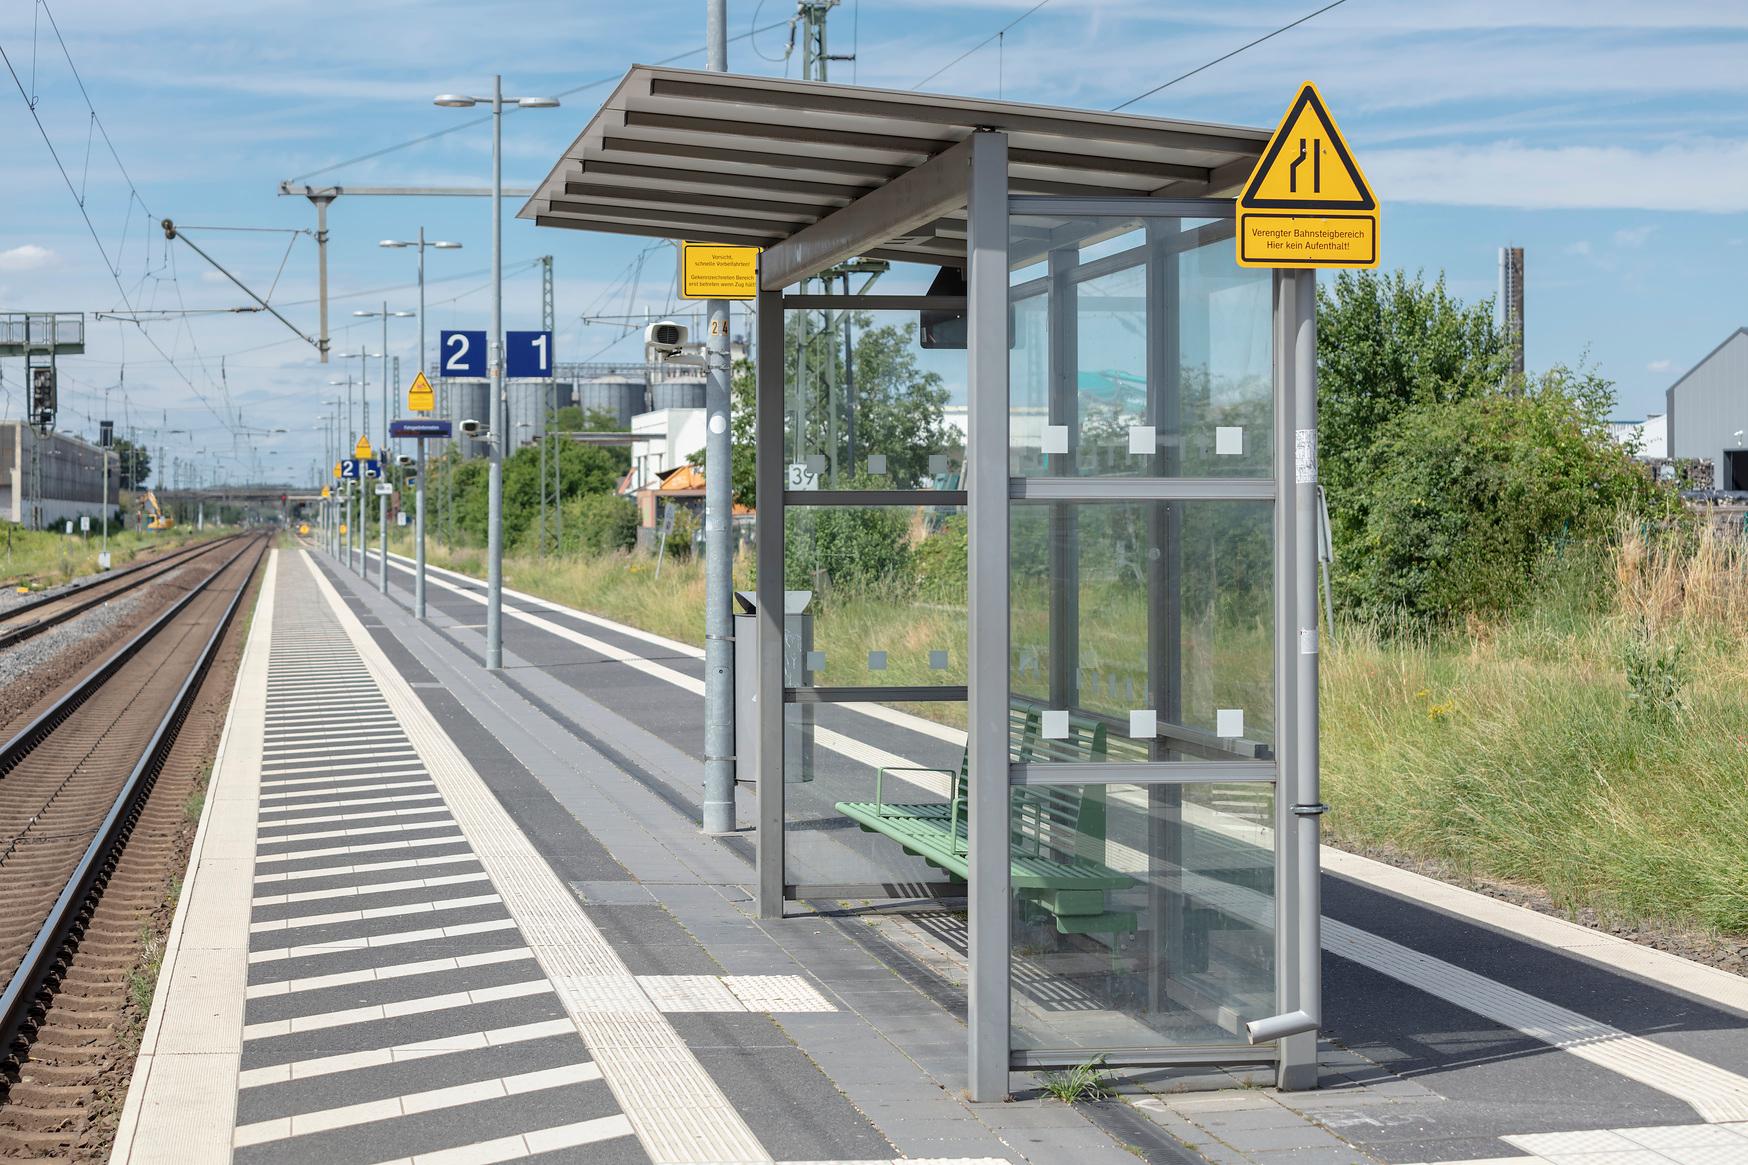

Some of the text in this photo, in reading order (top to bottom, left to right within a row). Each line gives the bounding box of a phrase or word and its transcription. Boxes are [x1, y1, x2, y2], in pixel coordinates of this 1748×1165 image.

[1252, 228, 1365, 239] Verengter Bahnsteigbereich
[1267, 241, 1350, 251] Hier kein Aufenthalt!
[446, 333, 470, 370] 2
[531, 334, 547, 370] 1
[343, 461, 353, 476] 2
